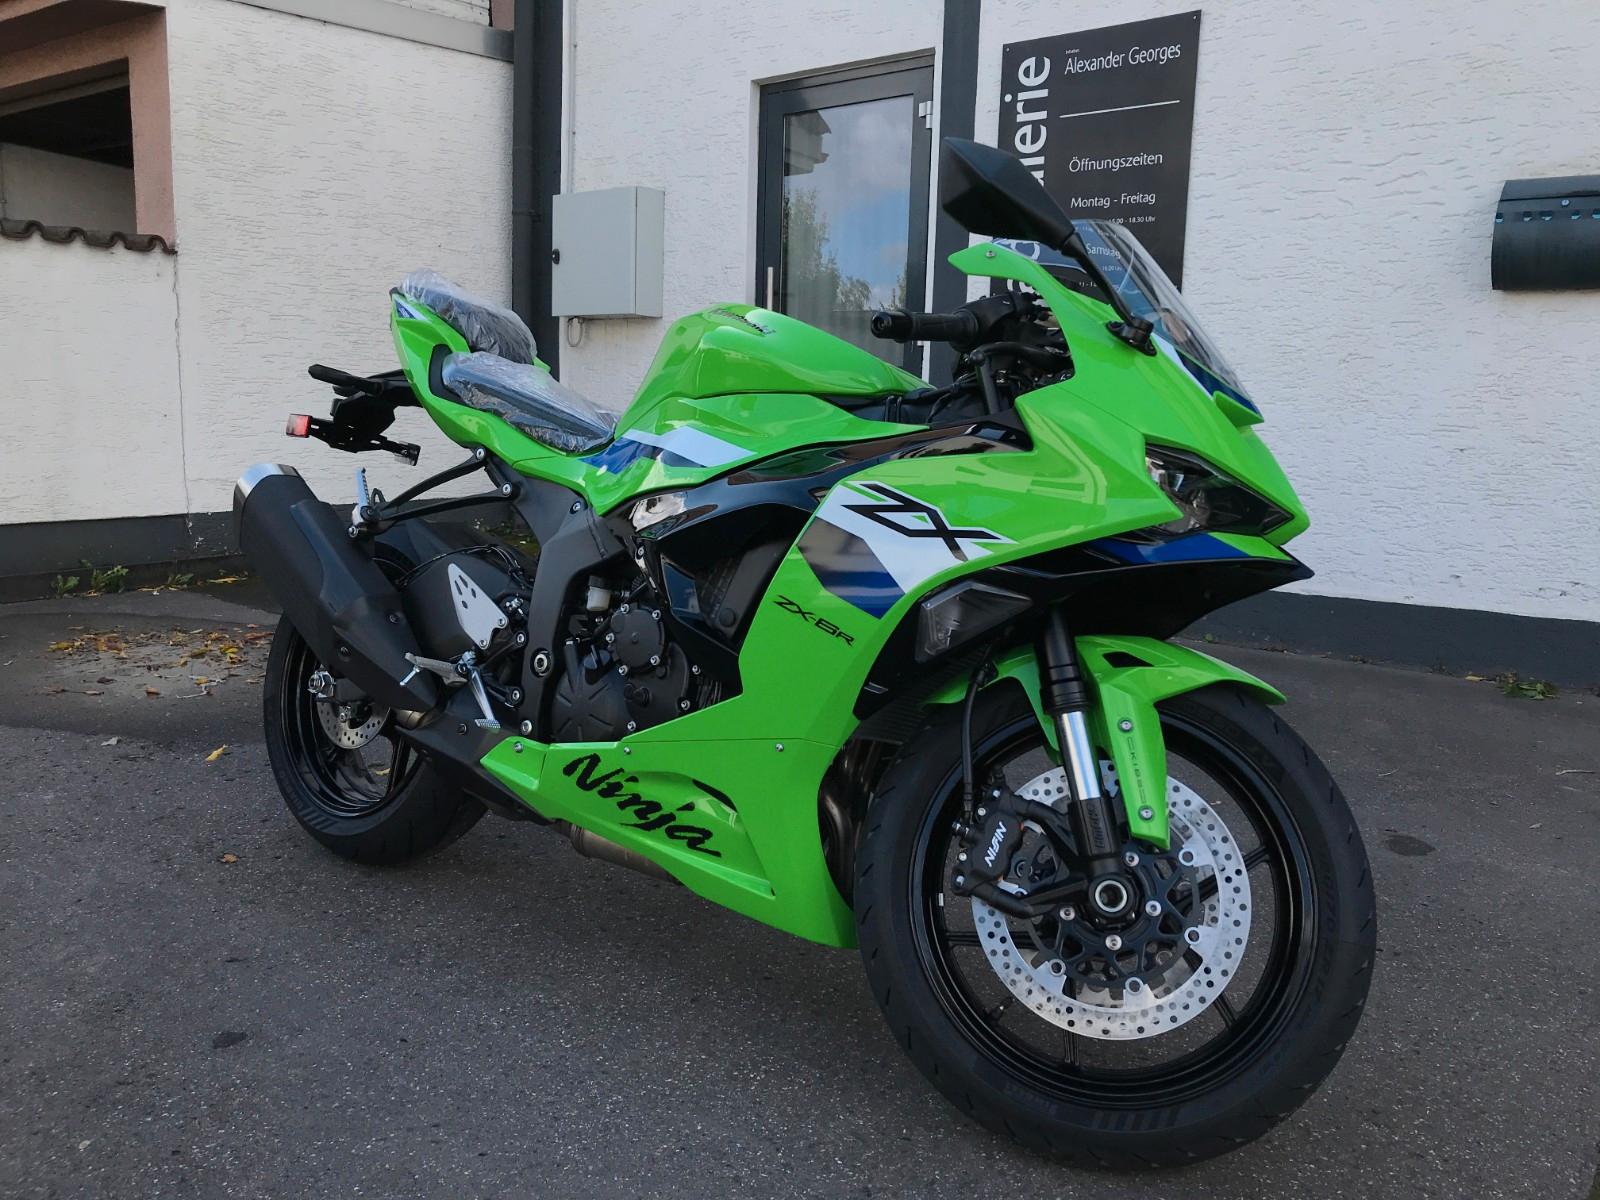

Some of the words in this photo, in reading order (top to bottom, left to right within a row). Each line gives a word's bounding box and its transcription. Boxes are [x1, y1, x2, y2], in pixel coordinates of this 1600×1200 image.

[1064, 51, 1126, 75] Alexander
[1128, 43, 1181, 65] Georges
[1069, 152, 1163, 173] Öffnungszeiten
[1070, 196, 1111, 209] Montag
[1120, 192, 1156, 205] Freitag
[771, 594, 856, 647] ZX-6R
[562, 752, 722, 858] Ninja
